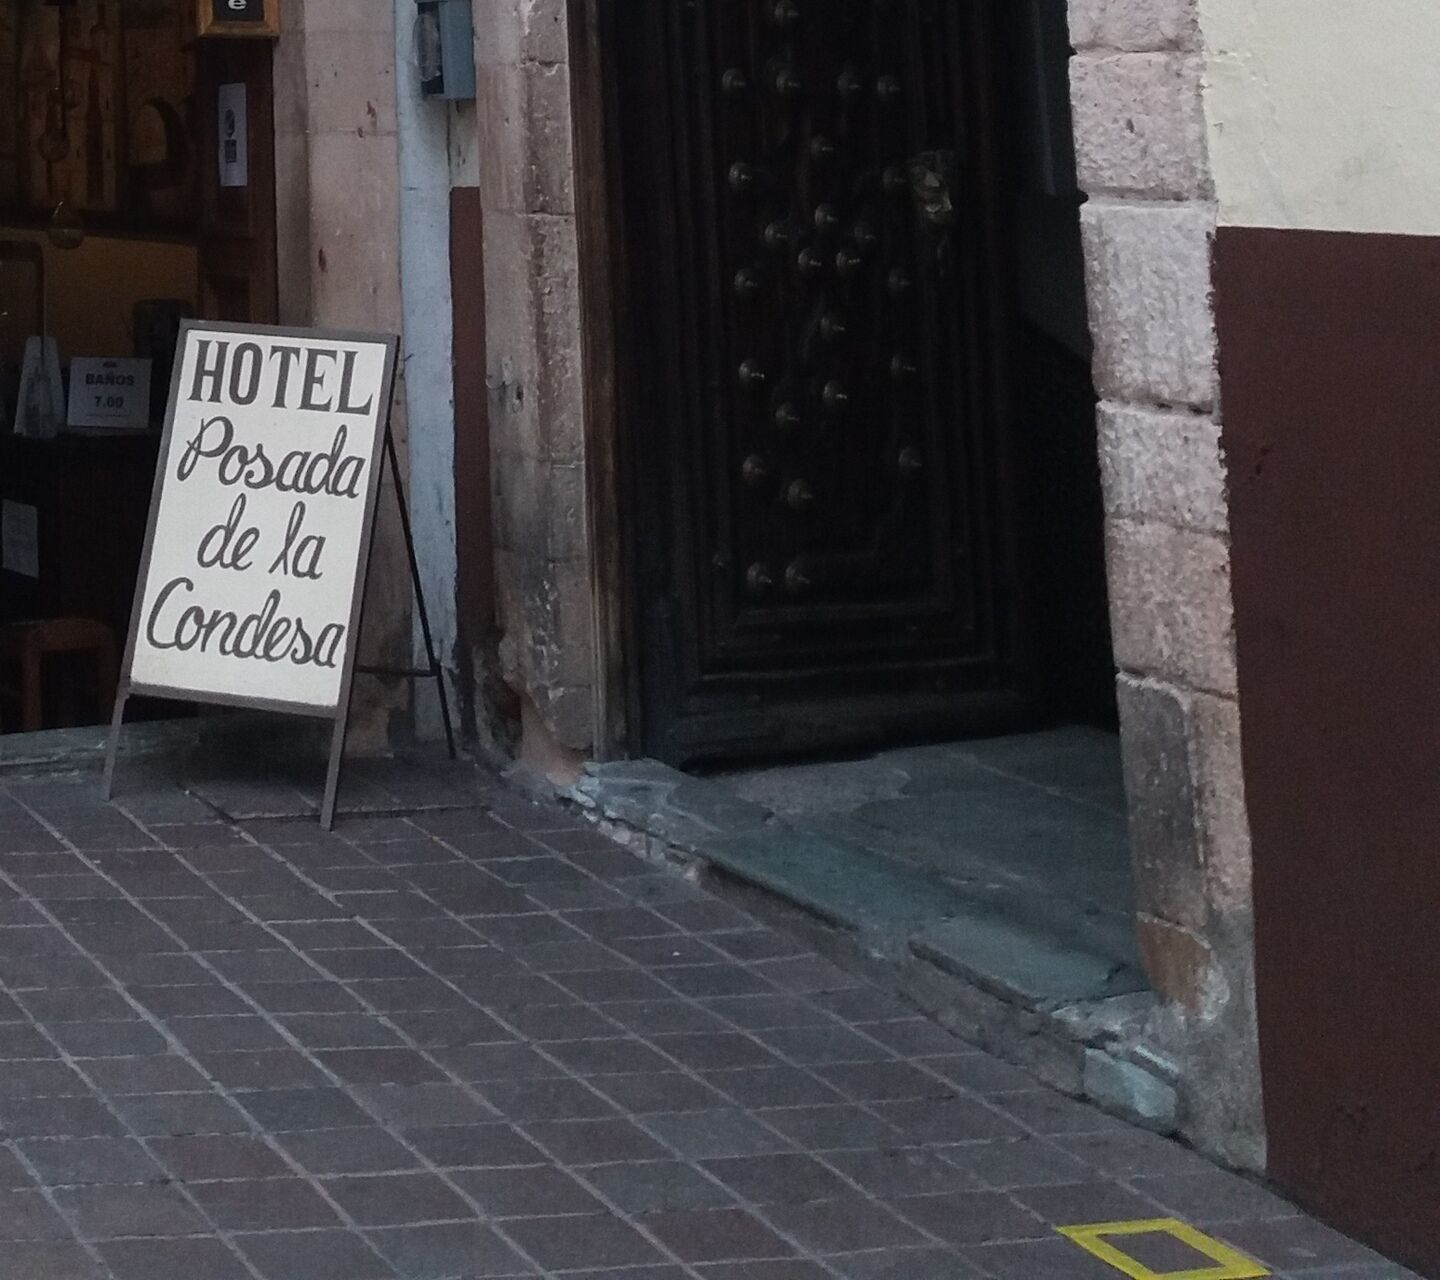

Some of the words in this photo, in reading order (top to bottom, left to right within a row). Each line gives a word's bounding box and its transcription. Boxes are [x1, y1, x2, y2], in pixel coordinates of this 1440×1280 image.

[187, 339, 374, 416] HOTEL
[176, 415, 366, 498] Posada
[197, 492, 260, 571] de
[268, 501, 326, 580] la
[146, 577, 346, 668] Condesa
